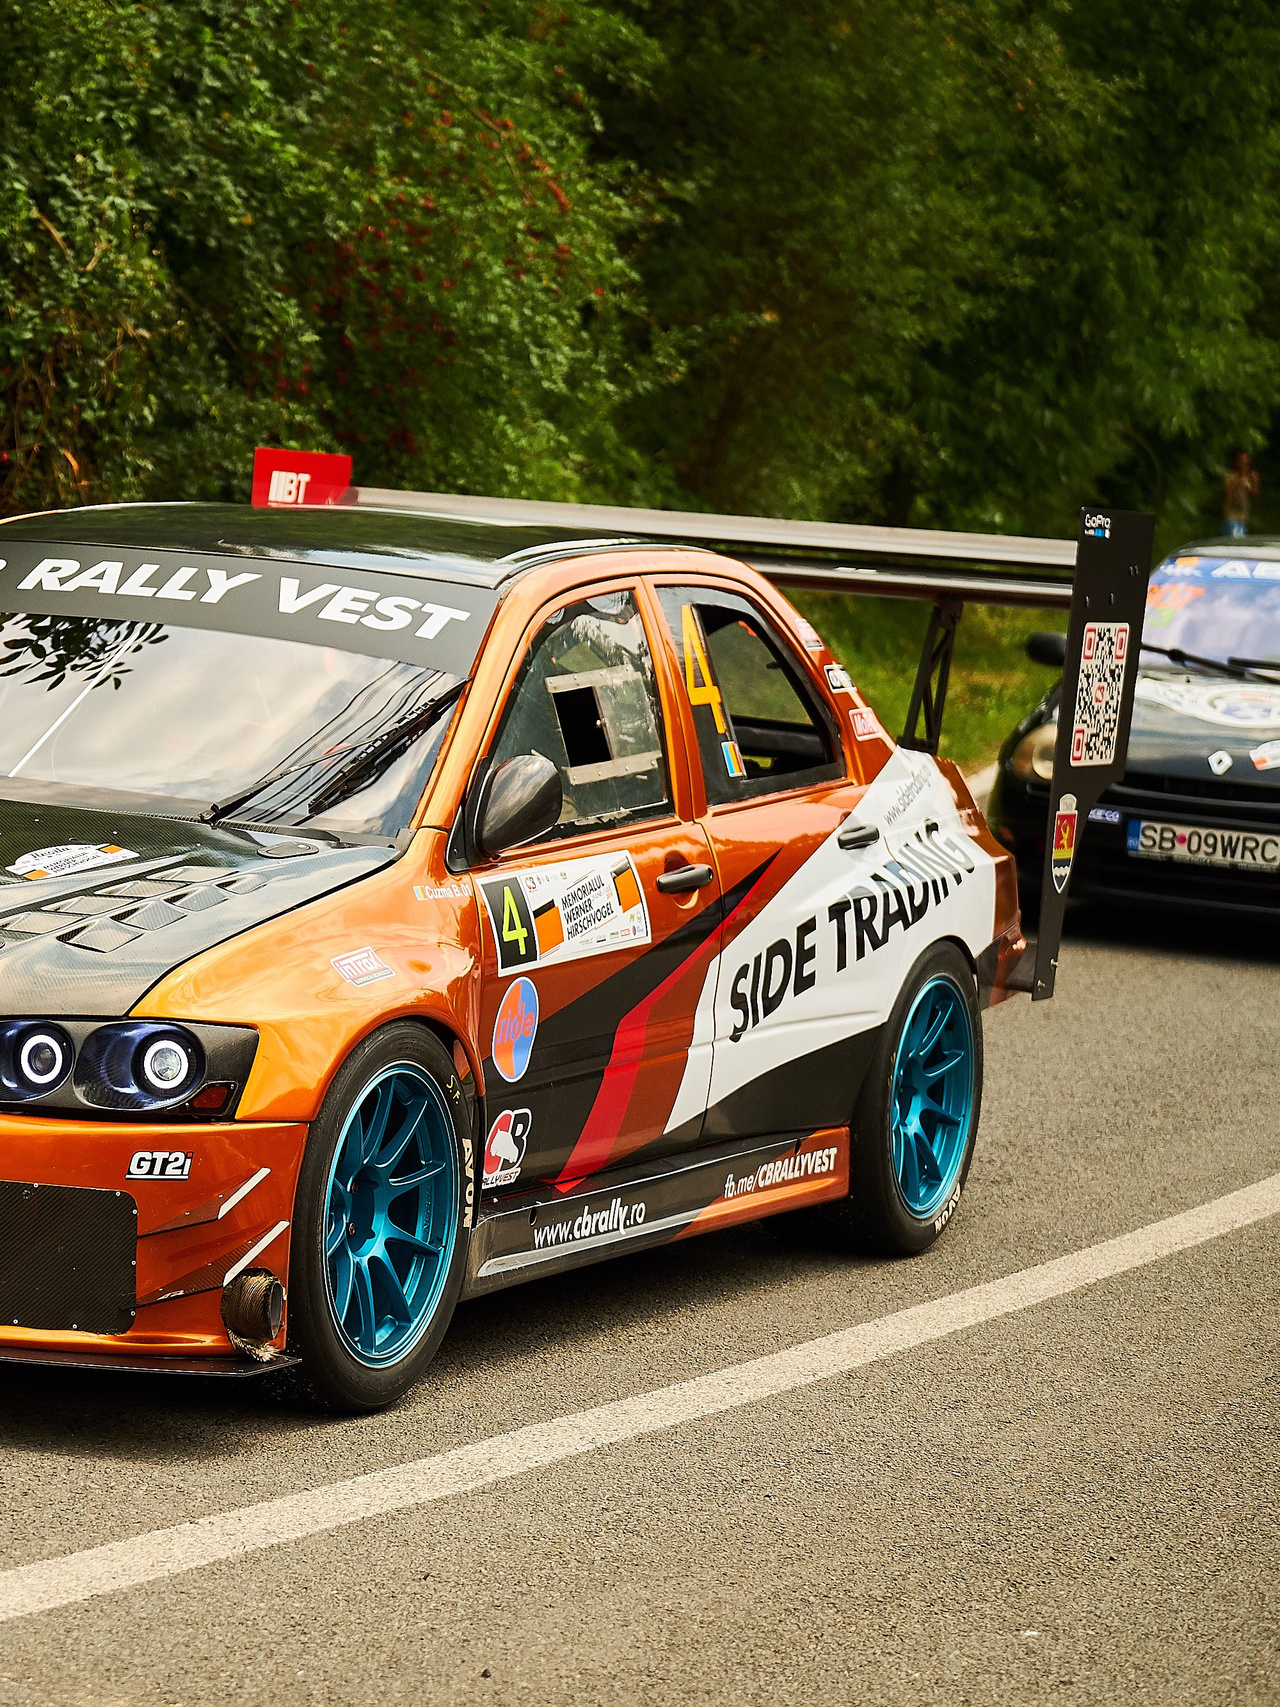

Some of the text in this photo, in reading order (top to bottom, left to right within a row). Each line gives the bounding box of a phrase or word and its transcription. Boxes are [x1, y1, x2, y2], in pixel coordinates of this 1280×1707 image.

[1085, 513, 1111, 529] GoPro
[17, 558, 262, 604] RALLY
[276, 577, 471, 641] VEST
[681, 604, 727, 735] 4
[1140, 825, 1176, 852] SB
[1186, 831, 1280, 863] 09WRC
[424, 885, 454, 899] Cuzma
[561, 874, 605, 911] MEMORIALUL
[563, 898, 594, 925] WERNER
[502, 886, 528, 955] 4
[566, 901, 615, 941] HIRSCHVOGEL
[729, 817, 975, 1043] SIDE TRADING
[496, 1001, 536, 1044] ride
[129, 1151, 193, 1176] GT2i
[461, 1138, 475, 1229] AVON
[723, 1147, 838, 1199] fb.me/CBRALLYVEST
[533, 1197, 646, 1250] www.cbrally.ro
[934, 1182, 962, 1235] AVON
